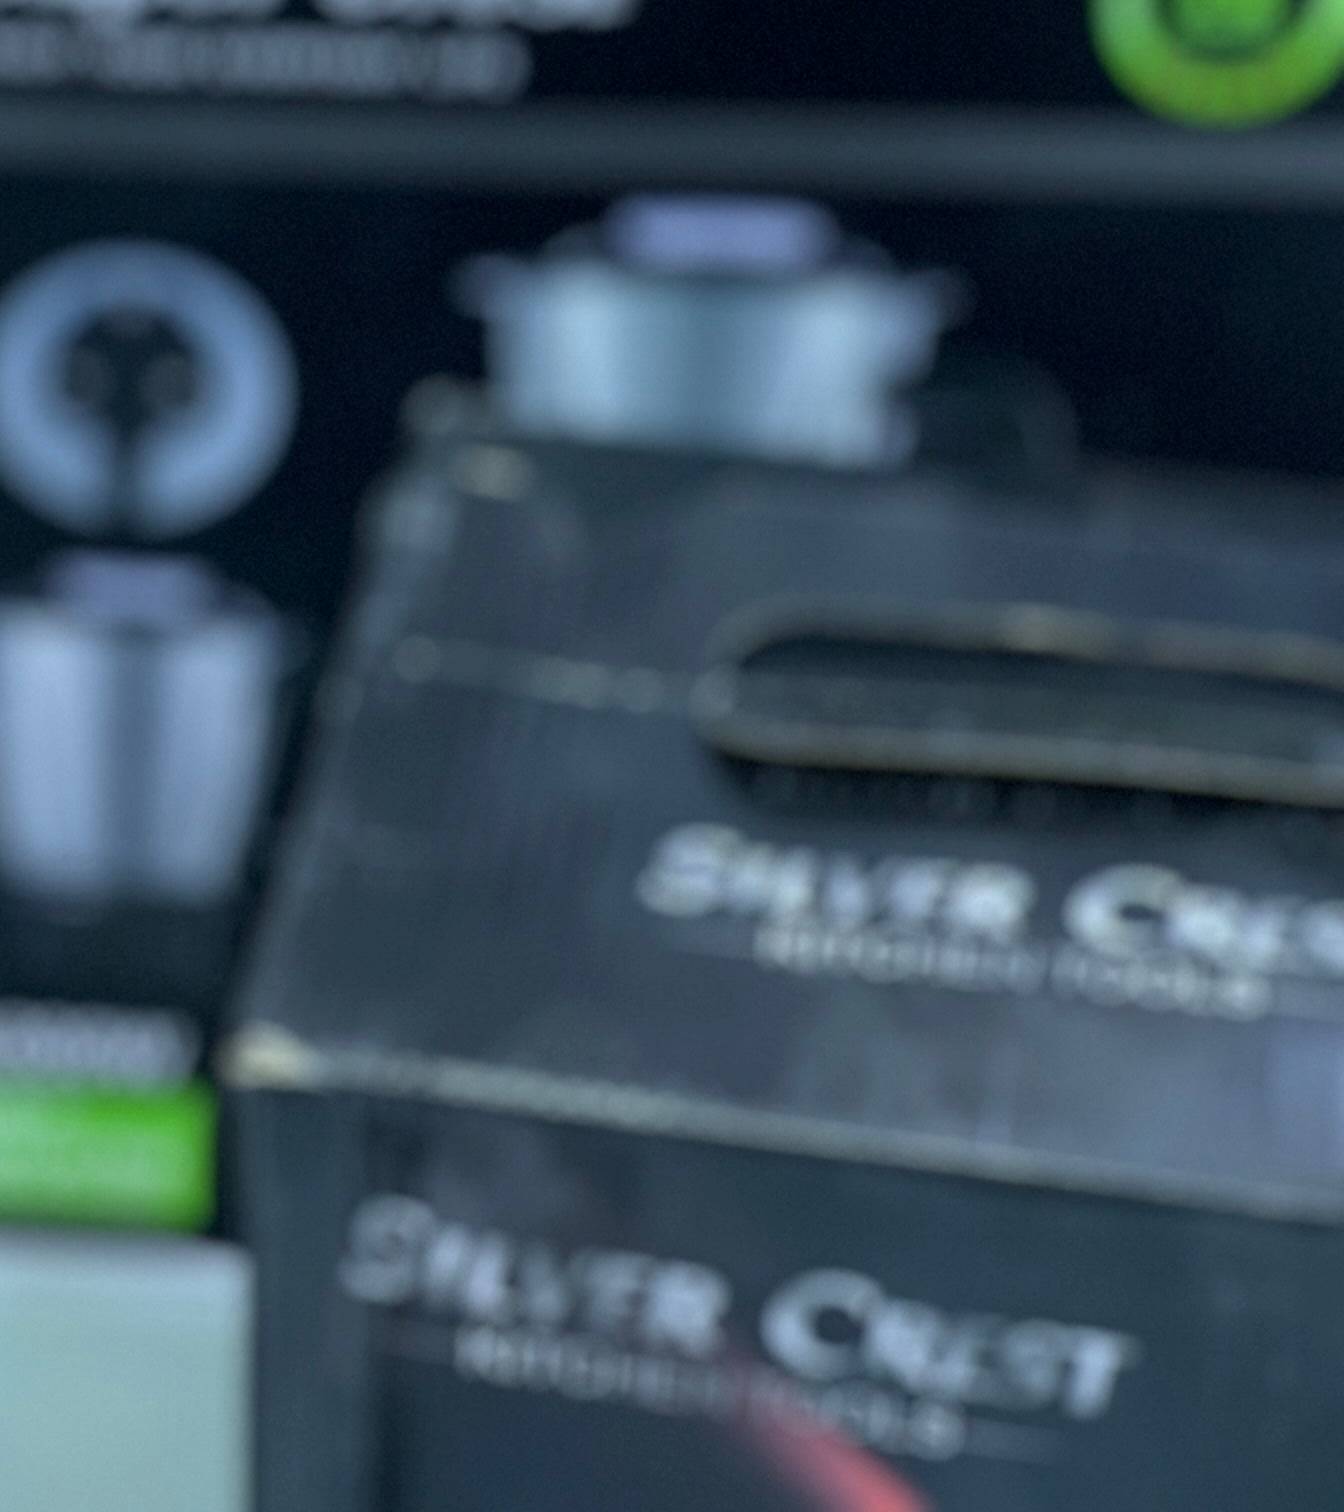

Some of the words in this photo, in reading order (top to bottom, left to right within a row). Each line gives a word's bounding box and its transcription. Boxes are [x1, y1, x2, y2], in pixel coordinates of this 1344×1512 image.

[636, 822, 1036, 948] SILVER
[337, 1192, 734, 1358] SILVER
[759, 1267, 1142, 1422] CREST
